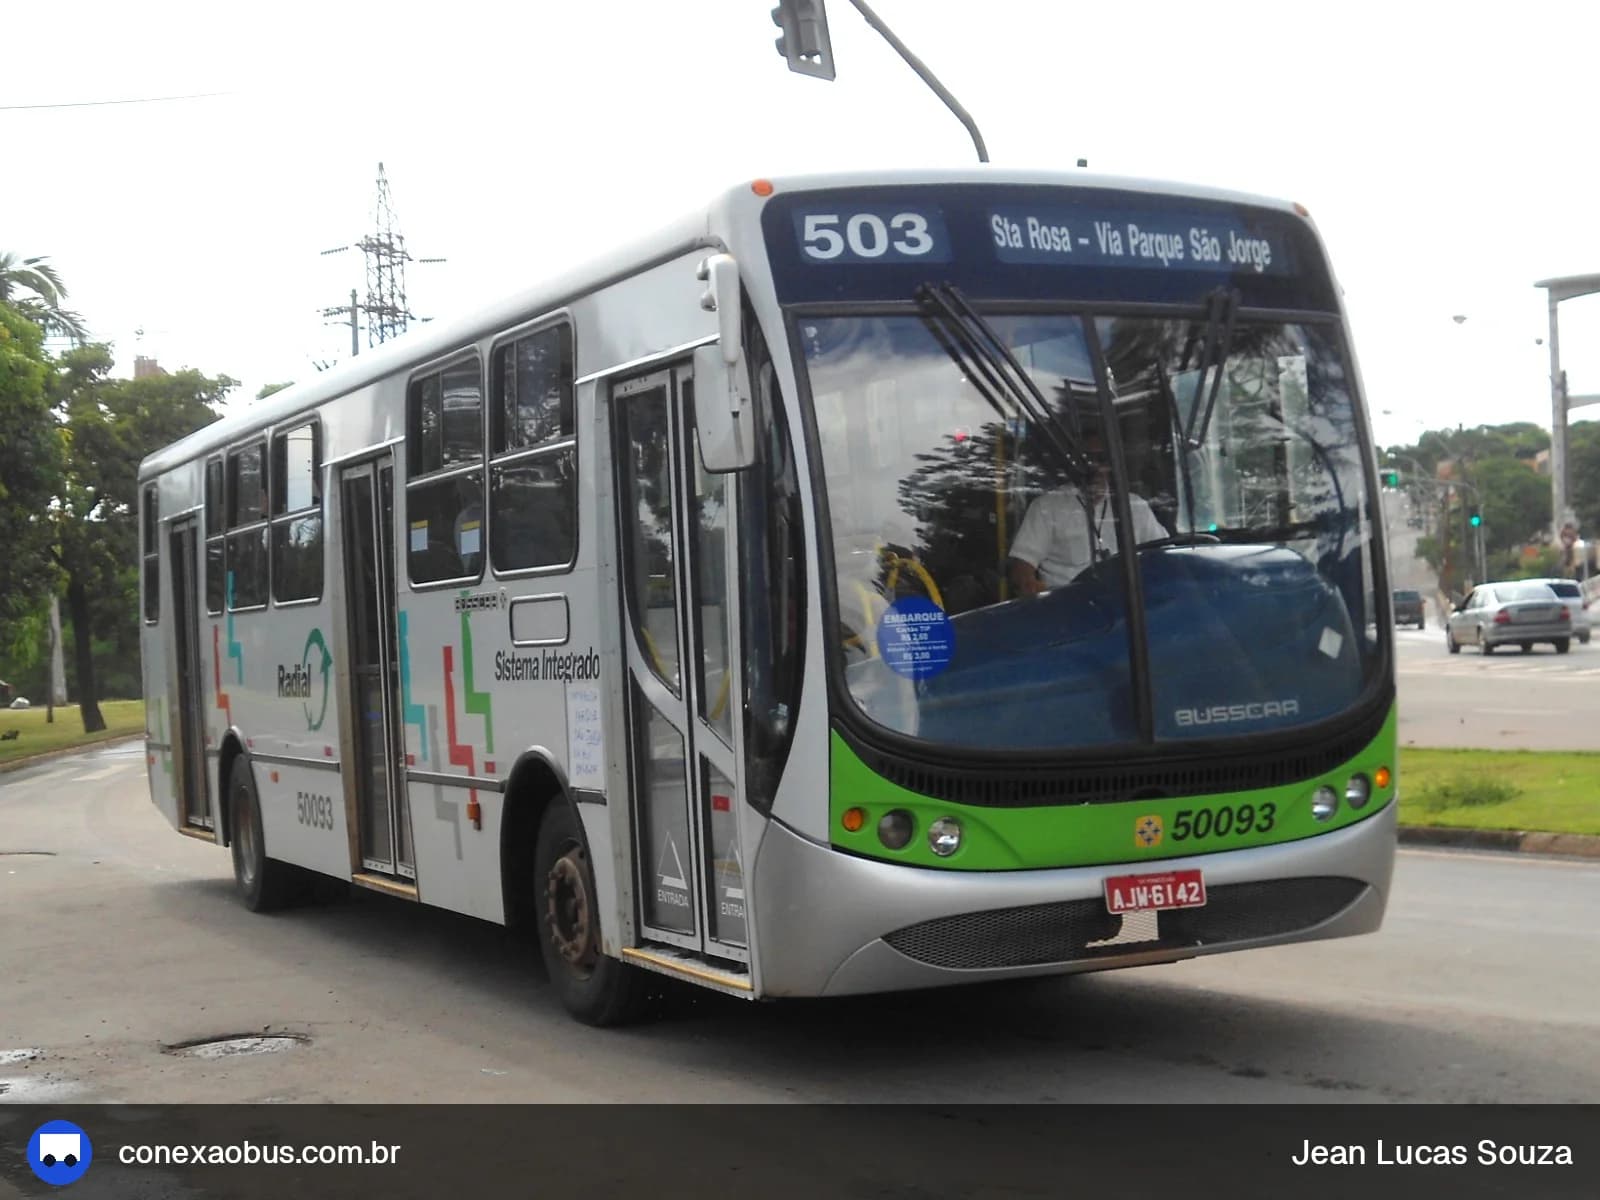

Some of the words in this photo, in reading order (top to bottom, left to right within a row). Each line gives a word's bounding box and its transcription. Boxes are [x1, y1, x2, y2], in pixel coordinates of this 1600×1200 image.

[803, 212, 934, 260] 503
[991, 213, 1024, 249] Sta
[1026, 216, 1072, 252] Rosa
[1094, 221, 1124, 256] Via
[1127, 223, 1184, 268] Parque
[1189, 227, 1221, 262] São
[1227, 230, 1272, 273] Jorge
[884, 612, 944, 624] EMBARQUE
[278, 664, 311, 698] Radial
[495, 650, 539, 681] Sistema
[542, 647, 600, 682] Integrado
[1175, 700, 1299, 727] BUSSCAR
[297, 791, 333, 830] 50093
[1171, 803, 1276, 841] 50093
[657, 889, 689, 907] ENTRADA
[721, 902, 744, 918] ENTRA
